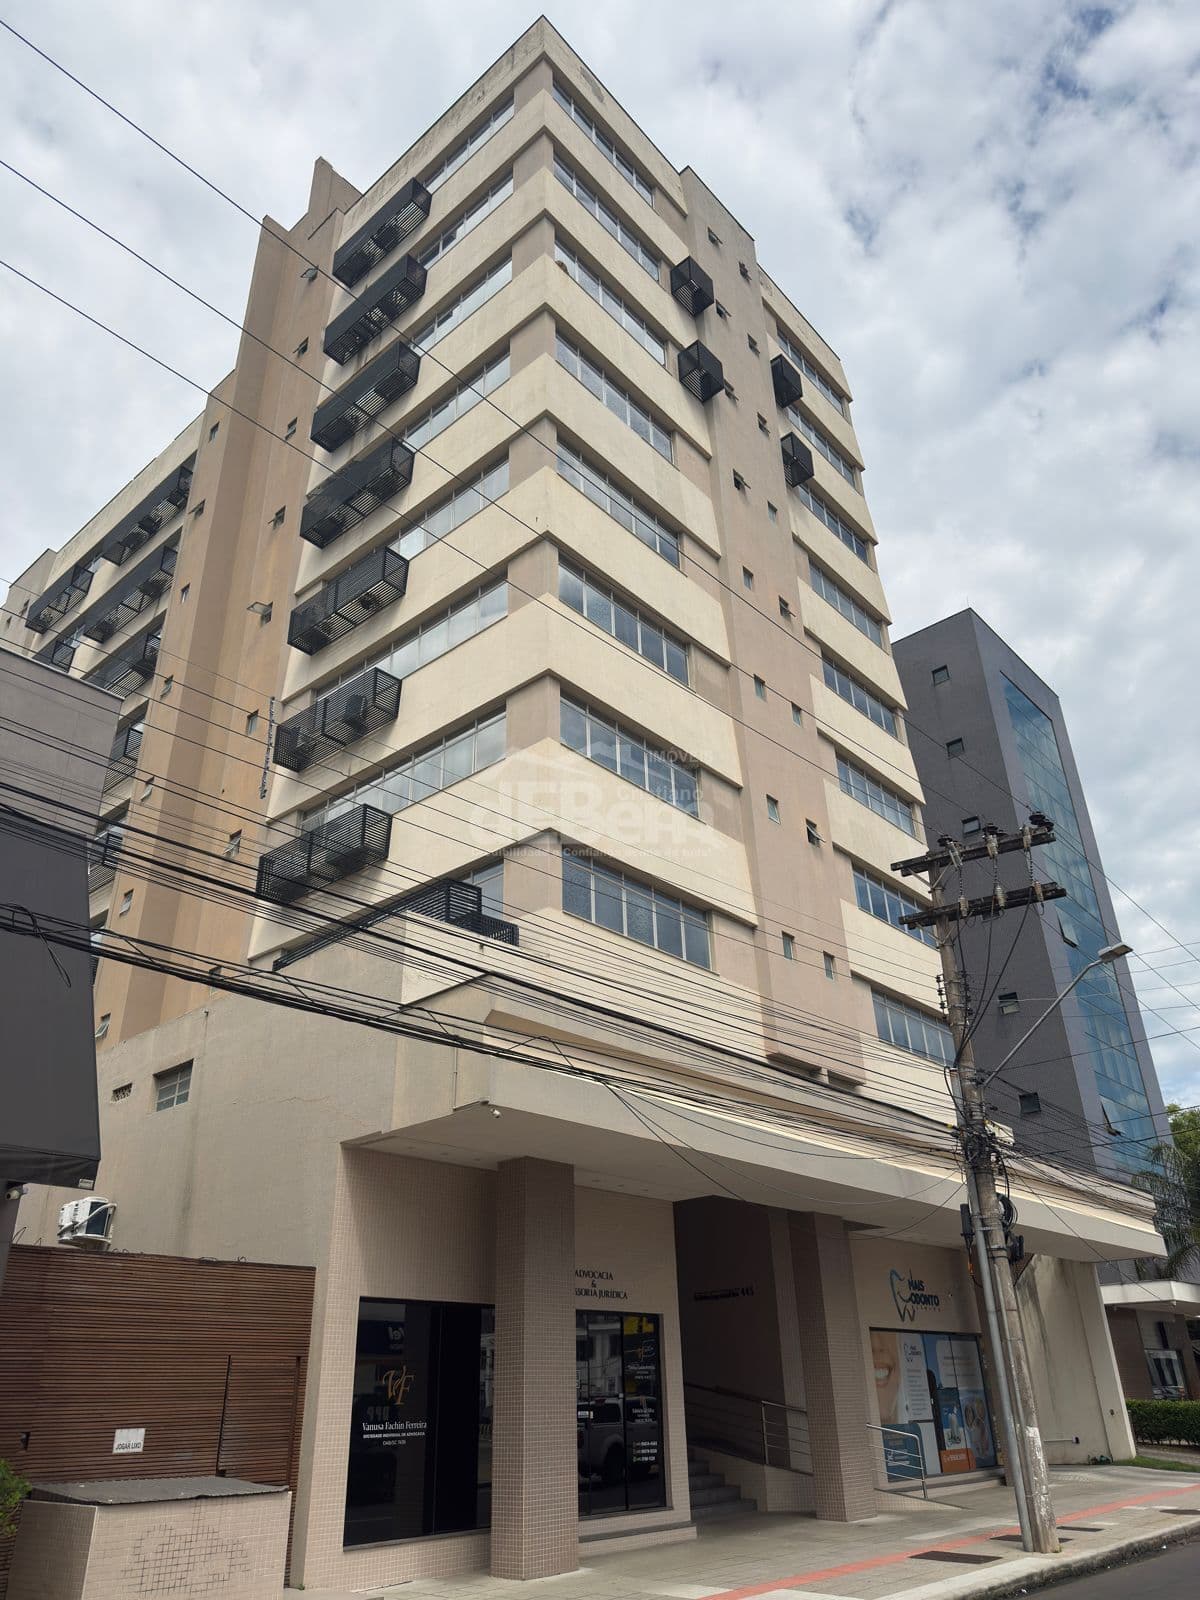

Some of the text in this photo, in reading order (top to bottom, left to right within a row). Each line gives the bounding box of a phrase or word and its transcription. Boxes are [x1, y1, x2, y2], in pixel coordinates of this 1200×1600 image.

[575, 1269, 614, 1281] ADVOCACIA
[908, 1279, 925, 1291] MAIS
[910, 1292, 940, 1306] ODONTO
[362, 1420, 427, 1431] Vanusa Fachin Ferreira
[115, 1441, 142, 1450] JOGAR LIXO
